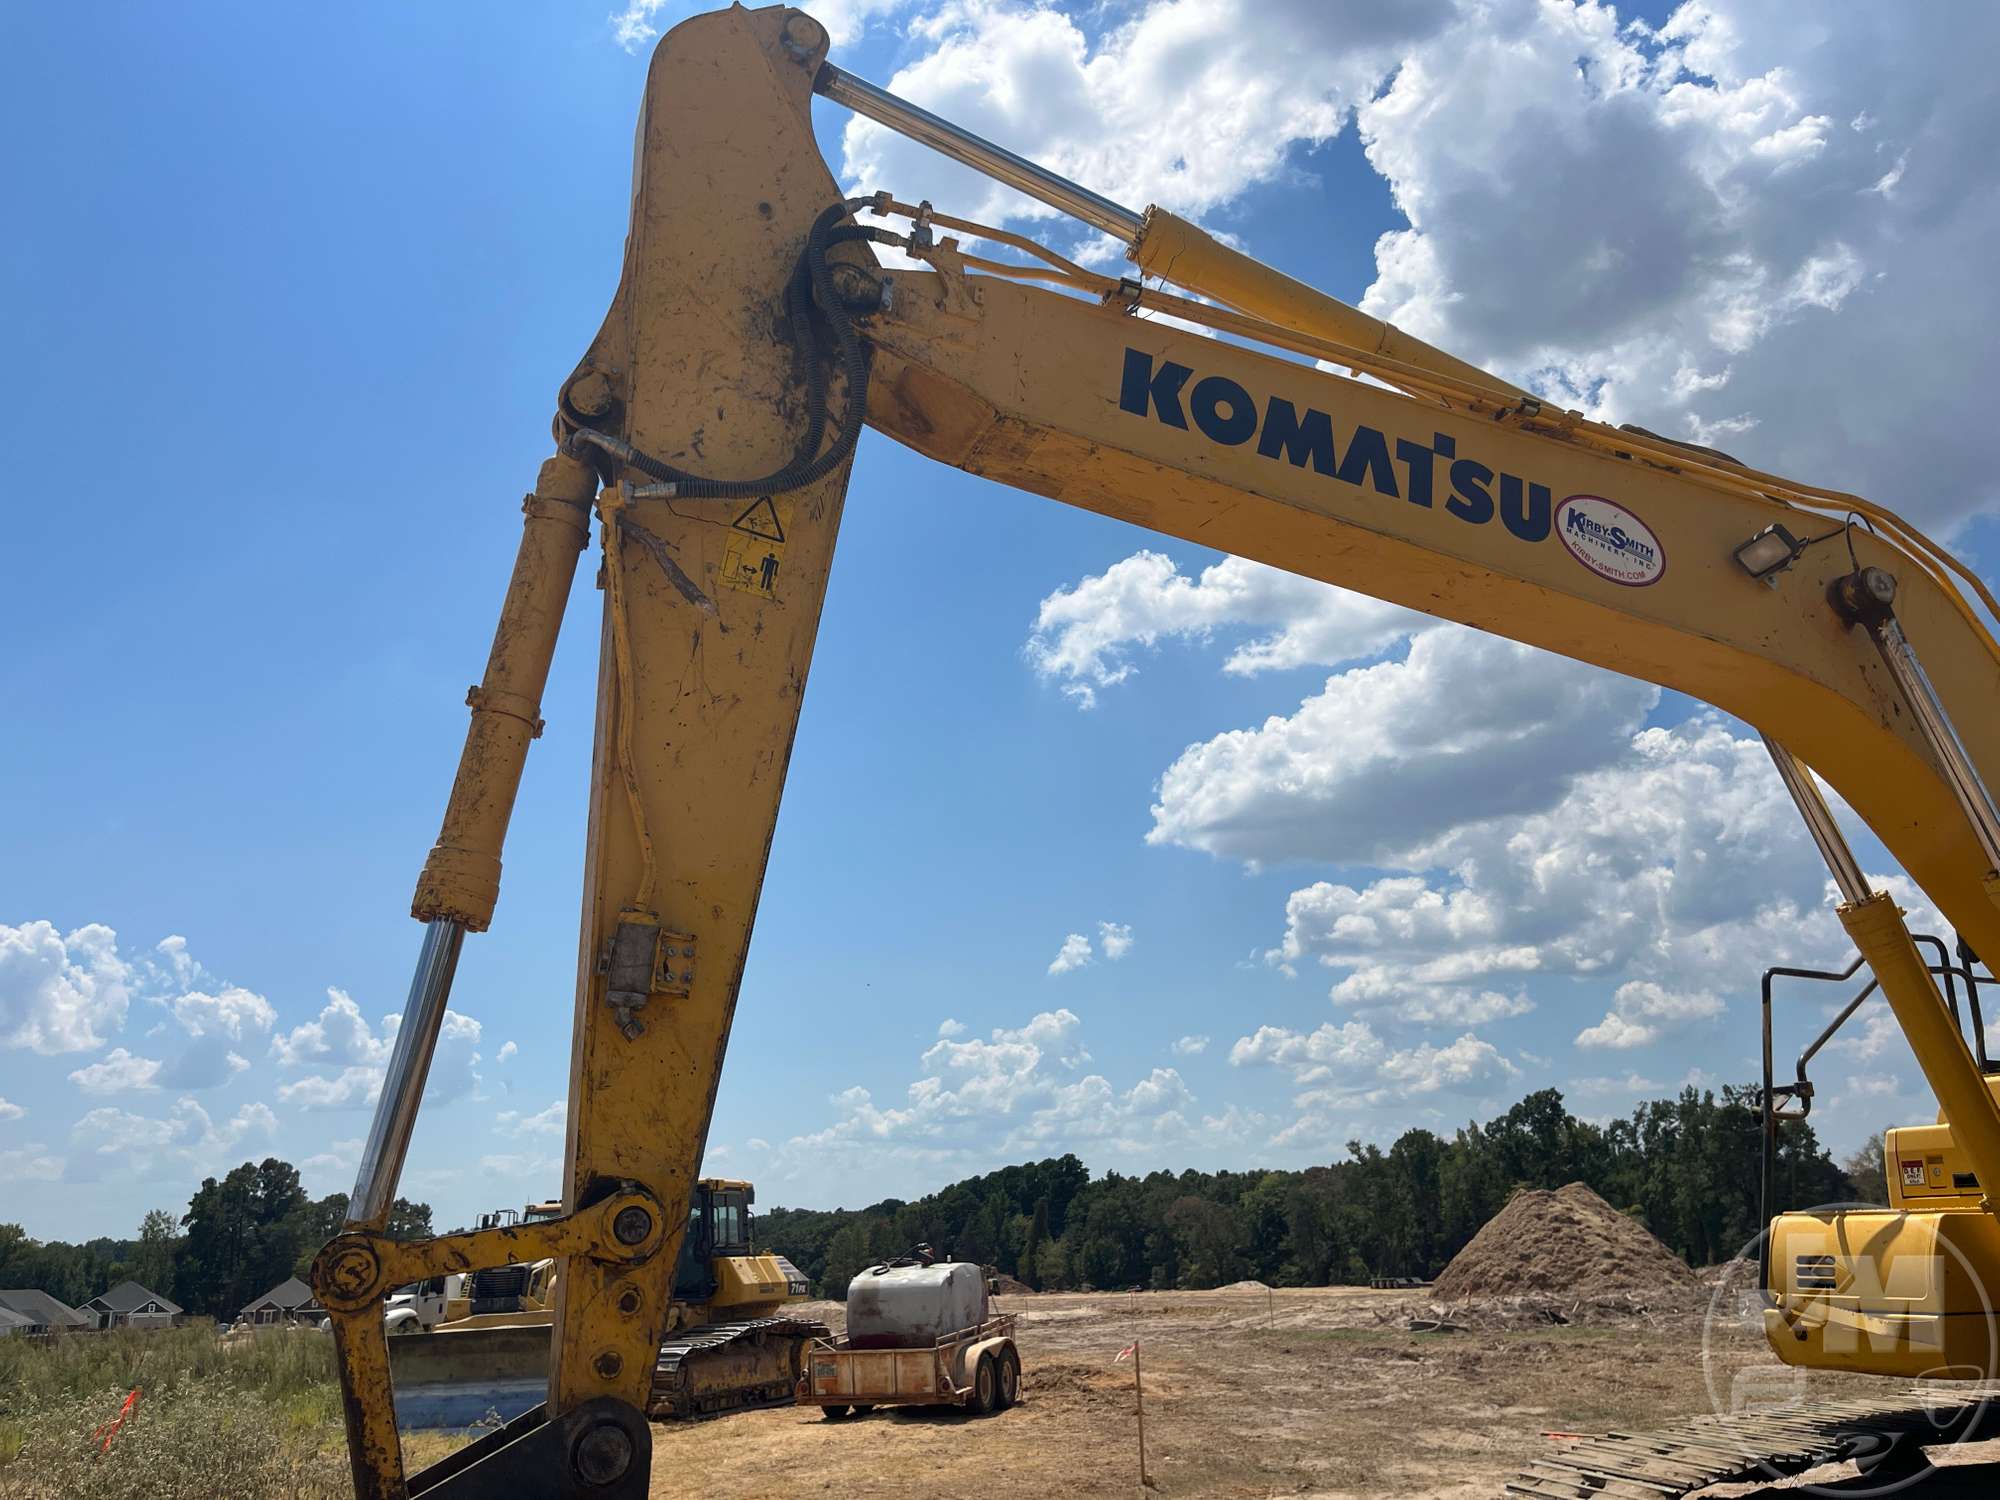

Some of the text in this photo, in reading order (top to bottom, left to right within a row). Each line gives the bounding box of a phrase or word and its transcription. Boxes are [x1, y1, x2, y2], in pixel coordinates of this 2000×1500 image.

[1119, 347, 1551, 542] KOMATSU
[1567, 507, 1654, 557] KIRBY-SMITH
[1571, 541, 1646, 580] KIRBY-SMITH.COM
